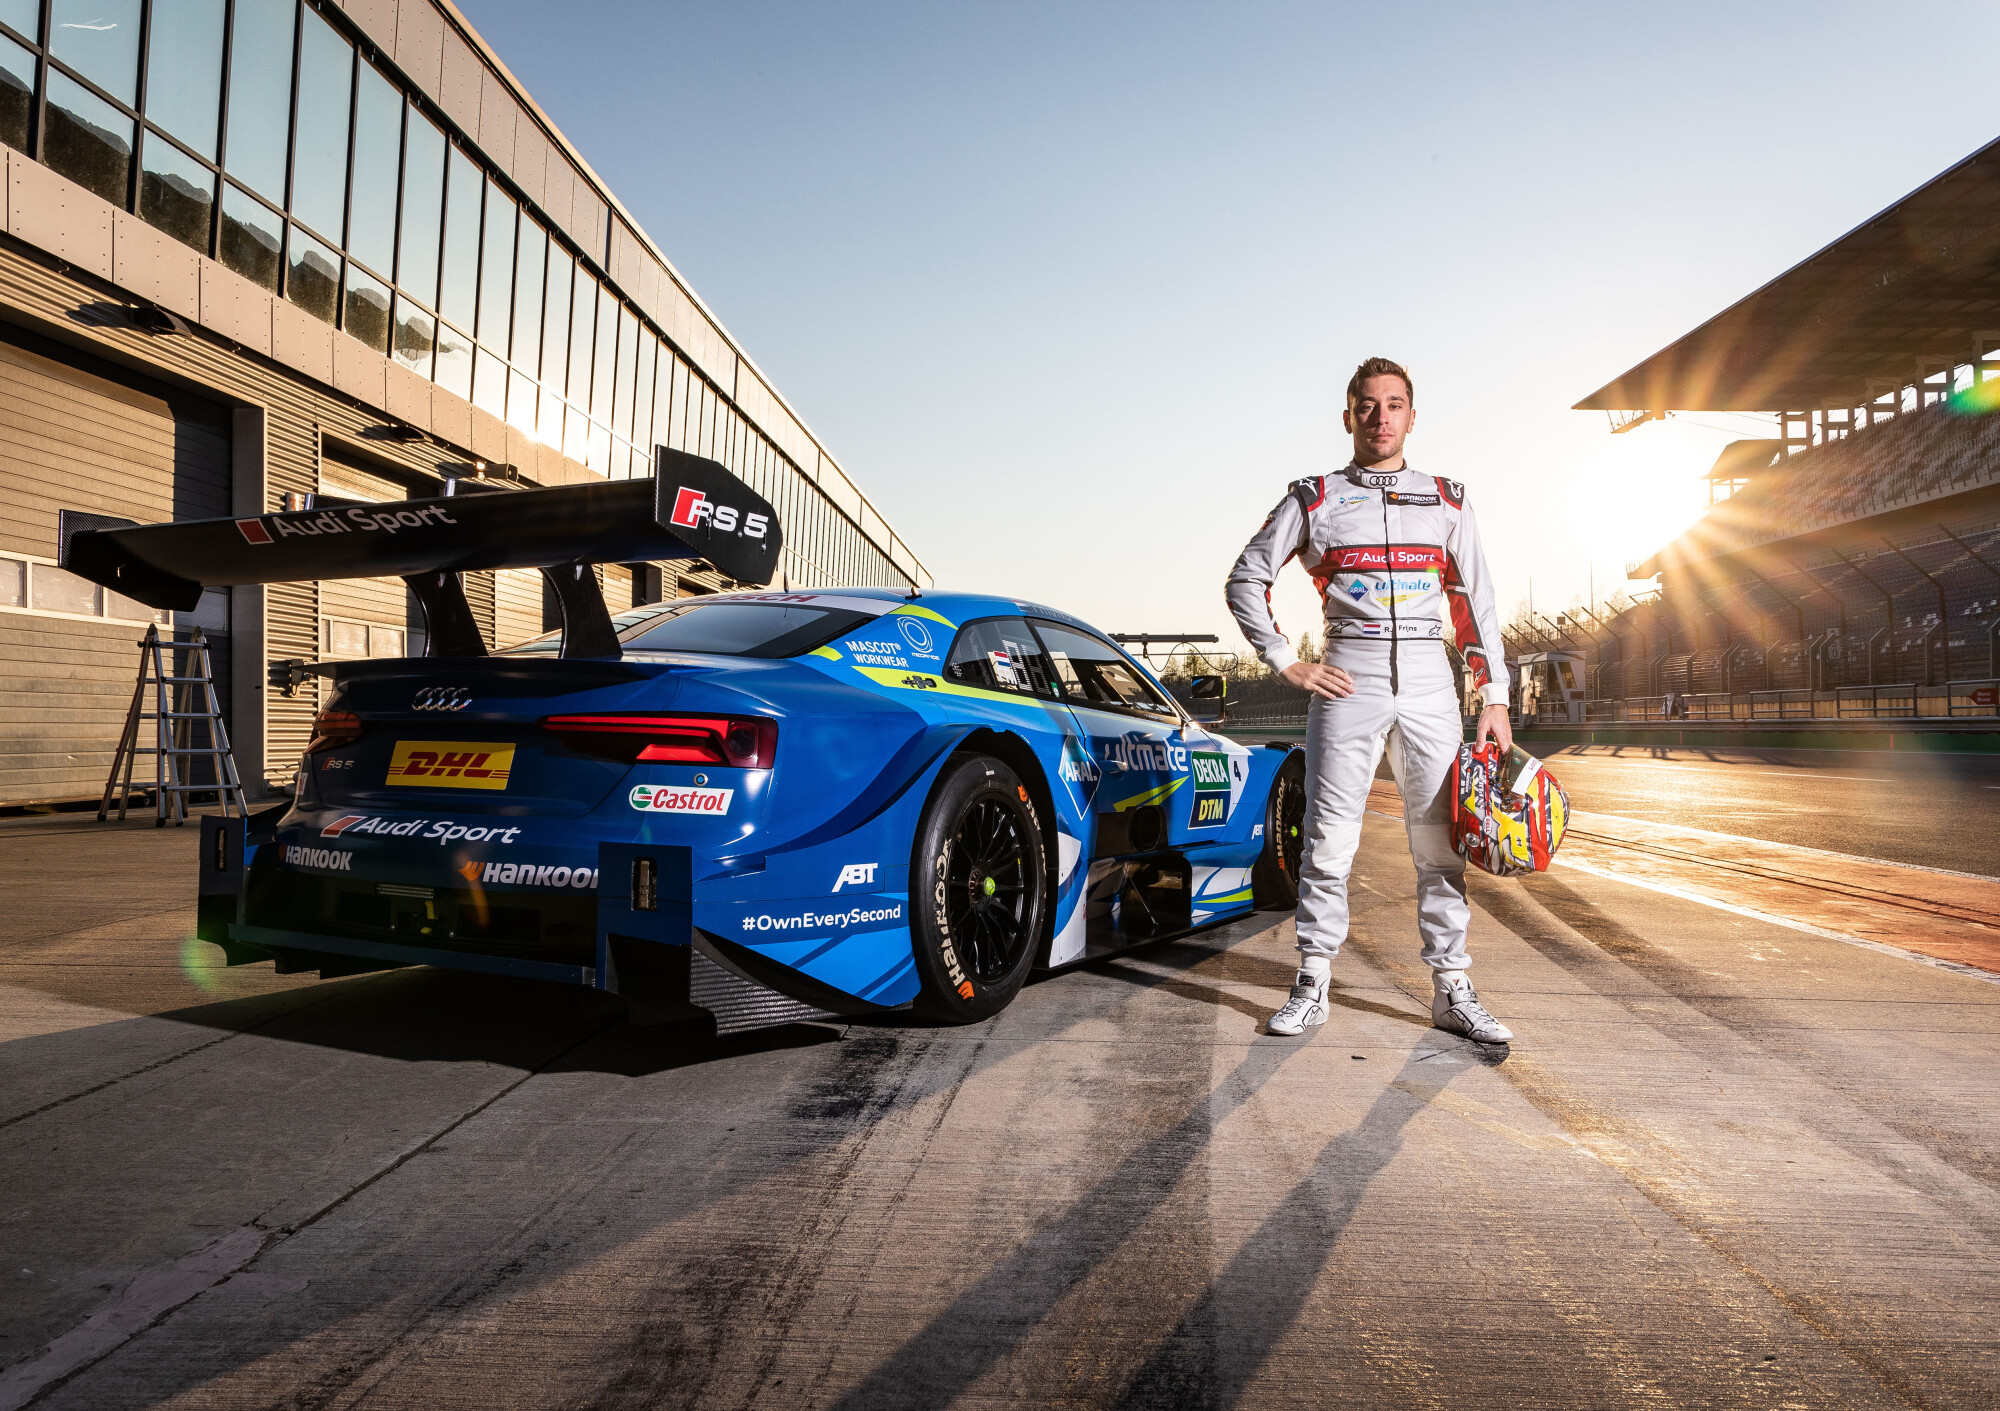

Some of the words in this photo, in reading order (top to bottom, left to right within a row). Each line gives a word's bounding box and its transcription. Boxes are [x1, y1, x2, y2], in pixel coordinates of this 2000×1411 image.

[272, 511, 352, 537] Audi
[347, 504, 457, 534] Sport
[687, 499, 739, 532] RS
[743, 512, 769, 538] 5
[1361, 552, 1394, 563] Audi
[1398, 552, 1436, 564] Sport
[1375, 579, 1430, 591] ultimate
[853, 653, 909, 668] WORKWEAR
[326, 759, 344, 770] RS
[344, 760, 355, 770] 5
[1104, 733, 1189, 772] ultimate
[402, 751, 493, 779] DHL
[1065, 761, 1098, 782] ARAL
[1193, 758, 1229, 783] DEKRA
[1233, 760, 1242, 782] 4
[653, 788, 726, 812] Castrol
[1198, 798, 1223, 821] DTM
[352, 816, 429, 837] Audi
[423, 821, 521, 846] Sport
[1252, 824, 1264, 840] ABT
[831, 863, 878, 893] ABT
[742, 904, 901, 930] #OwnEverySecond
